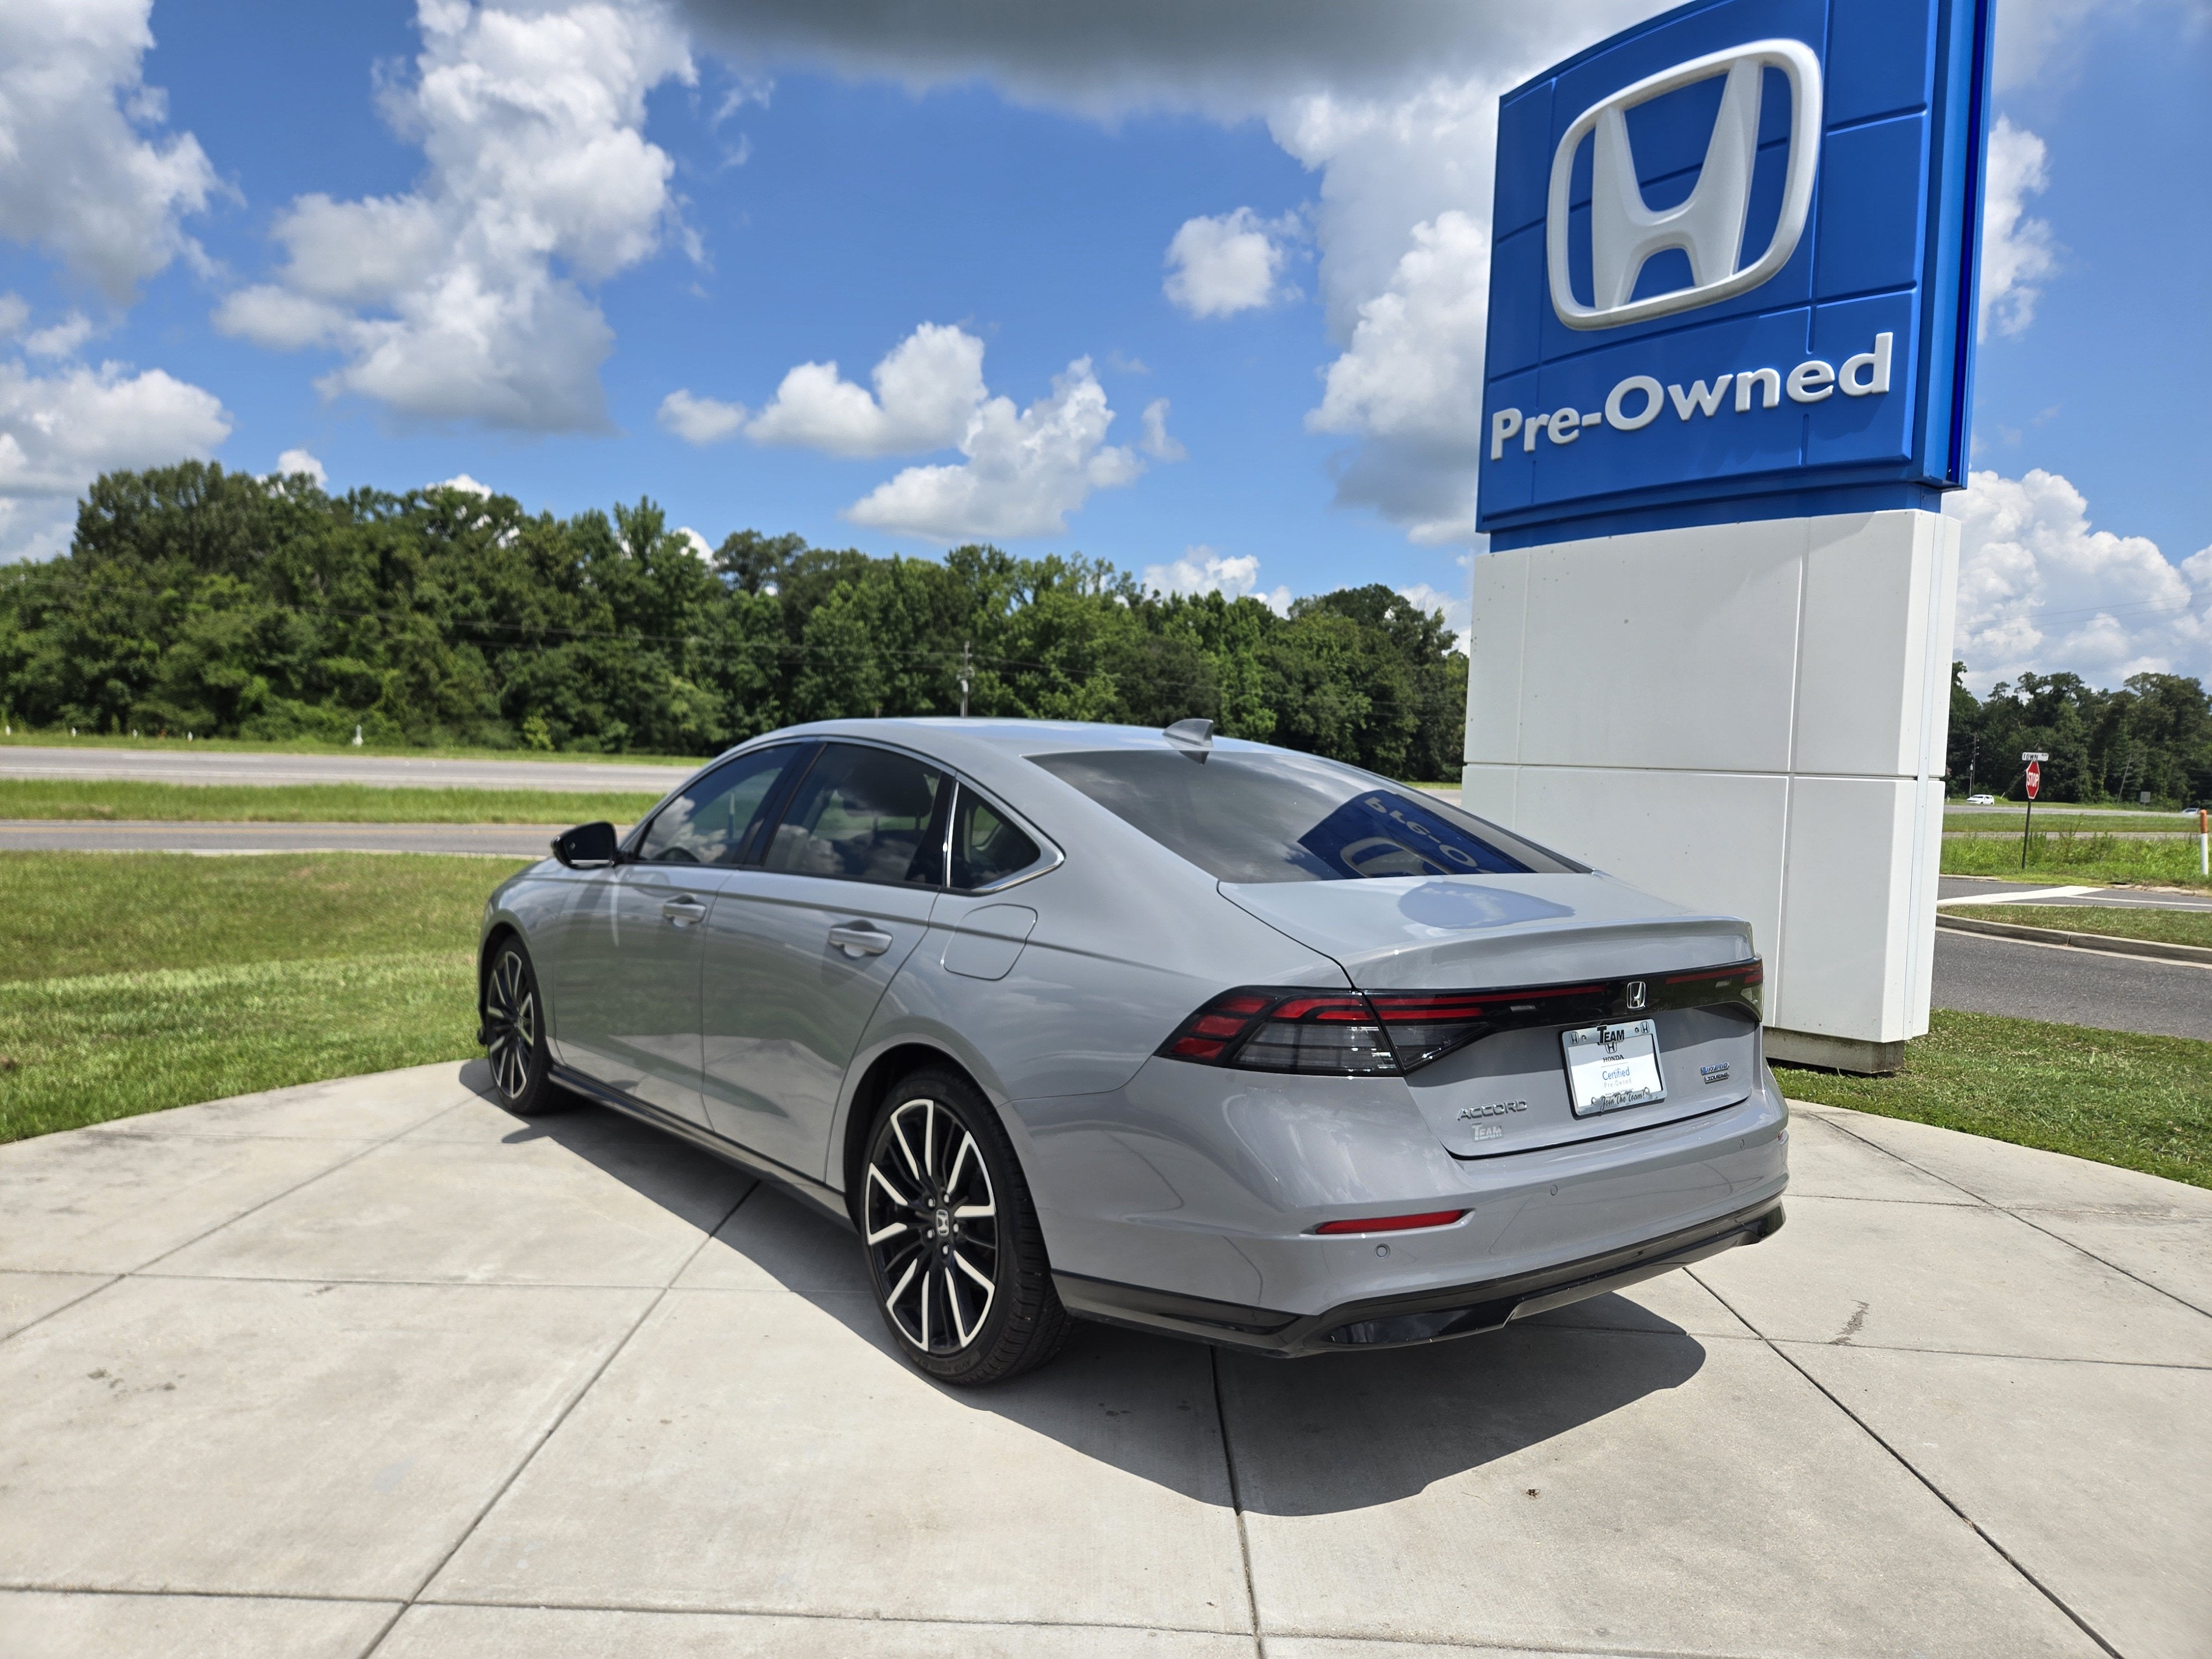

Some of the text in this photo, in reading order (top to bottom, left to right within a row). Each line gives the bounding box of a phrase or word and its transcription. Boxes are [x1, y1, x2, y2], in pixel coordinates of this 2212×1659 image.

[1490, 332, 1893, 461] Pre-Owned
[2027, 771, 2039, 787] STOP
[1602, 1066, 1630, 1080] Certified
[1707, 1072, 1729, 1081] TOURING
[1604, 1078, 1631, 1088] Pre-Owned
[1600, 1095, 1615, 1110] Join
[1614, 1092, 1626, 1104] The
[1457, 1100, 1527, 1121] ACCORD
